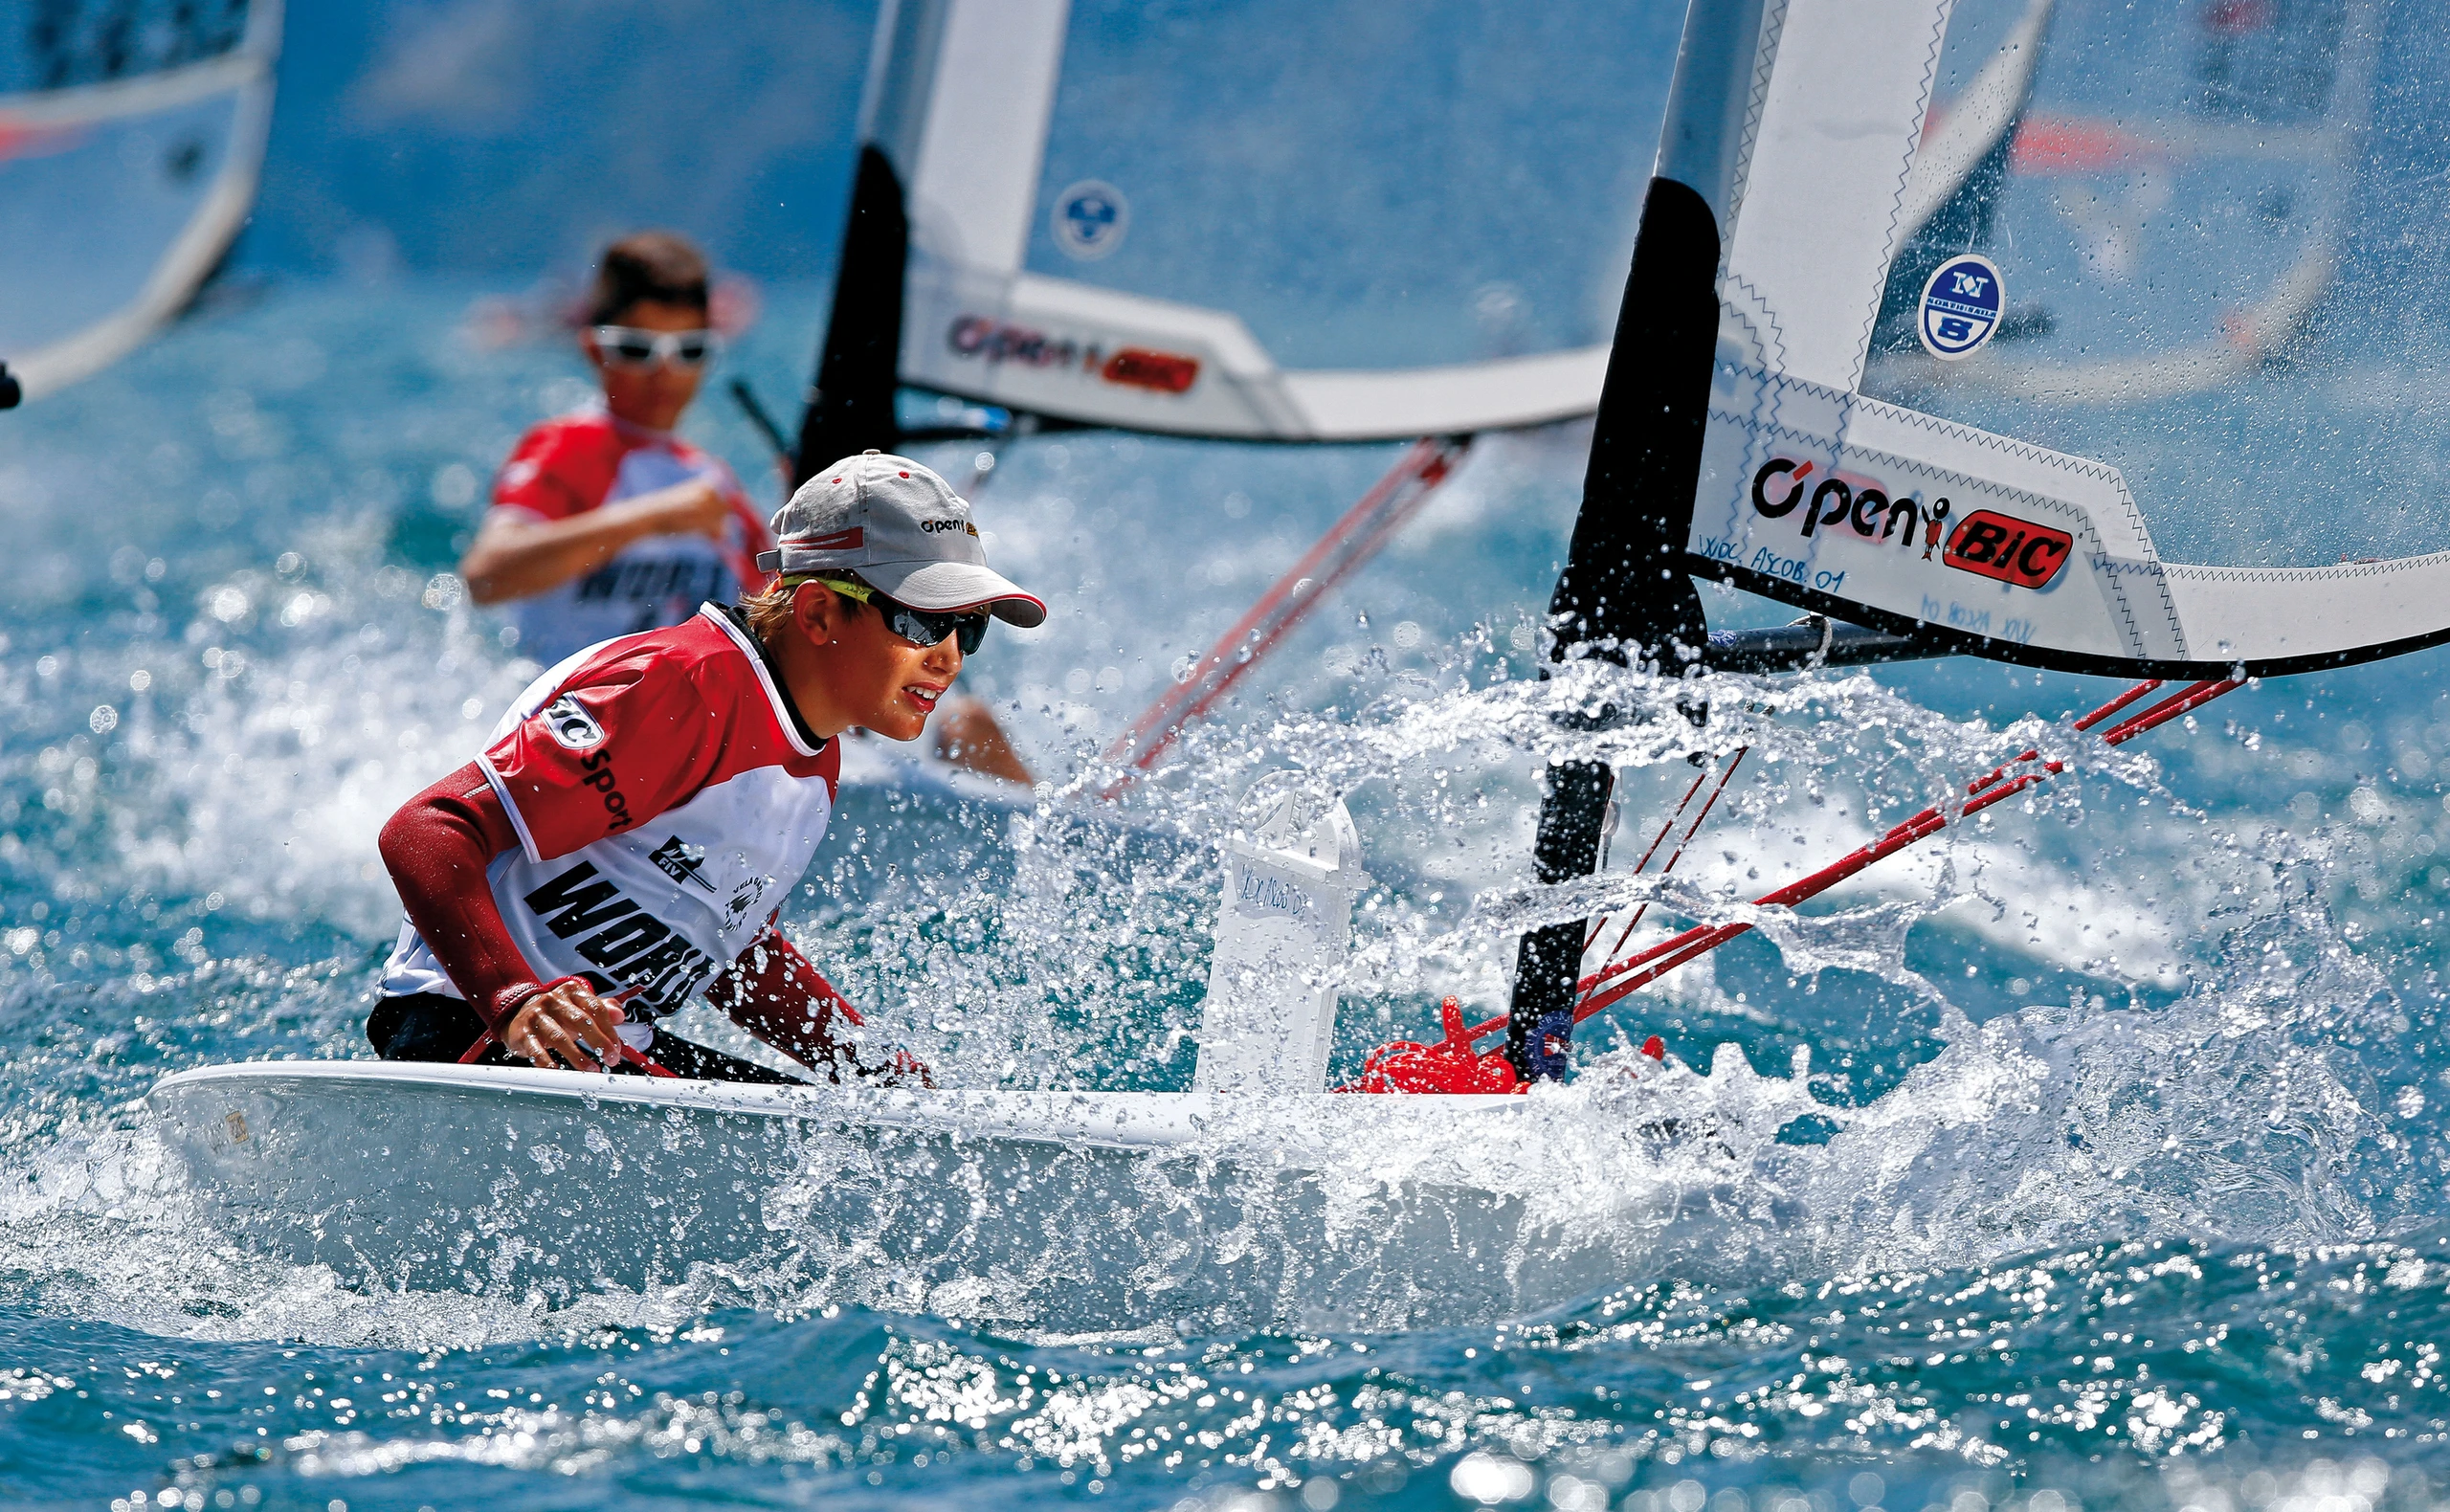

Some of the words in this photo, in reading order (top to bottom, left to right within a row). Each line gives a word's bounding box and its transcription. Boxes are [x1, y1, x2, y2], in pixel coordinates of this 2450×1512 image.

[1815, 570, 1845, 593] 01
[581, 748, 633, 831] Sport
[657, 857, 681, 878] FIV
